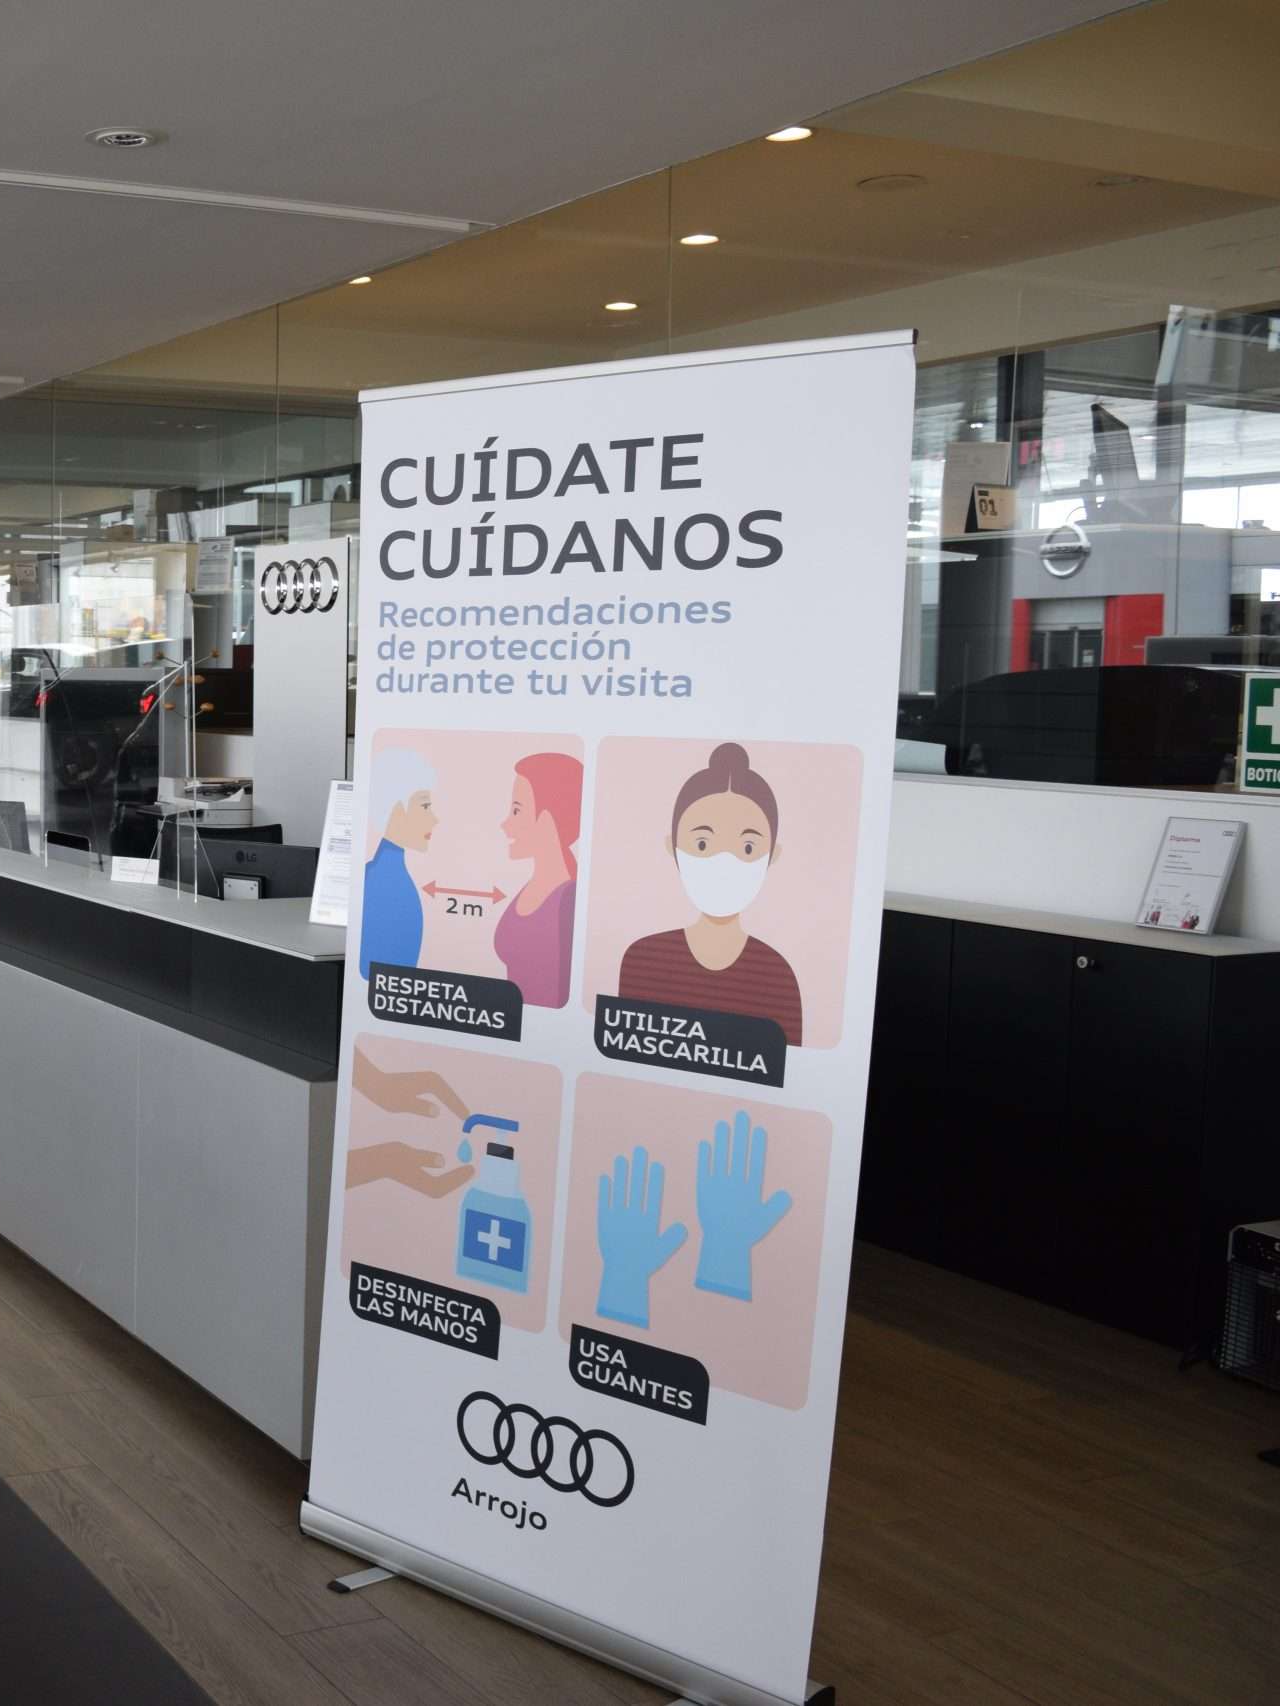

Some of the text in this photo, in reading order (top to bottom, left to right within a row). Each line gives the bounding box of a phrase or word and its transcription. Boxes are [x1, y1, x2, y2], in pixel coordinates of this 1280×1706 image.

[380, 433, 704, 509] CUÍDATE
[979, 498, 998, 516] 01
[379, 509, 783, 581] CUÍDANOS
[378, 595, 732, 628] Recomendaciones
[377, 631, 631, 668] de protección
[375, 666, 693, 698] durante tu visita
[445, 898, 483, 917] 2 m
[375, 974, 468, 1003] RESPETA
[373, 993, 505, 1029] DISTANCIAS
[604, 1007, 707, 1041] UTILIZA
[602, 1030, 768, 1074] MASCARILLA
[357, 1274, 486, 1326] DESINFECTA
[356, 1293, 478, 1344] LAS MANOS
[579, 1338, 628, 1369] USA
[577, 1360, 693, 1410] GUANTES
[451, 1477, 548, 1531] Arrojo
